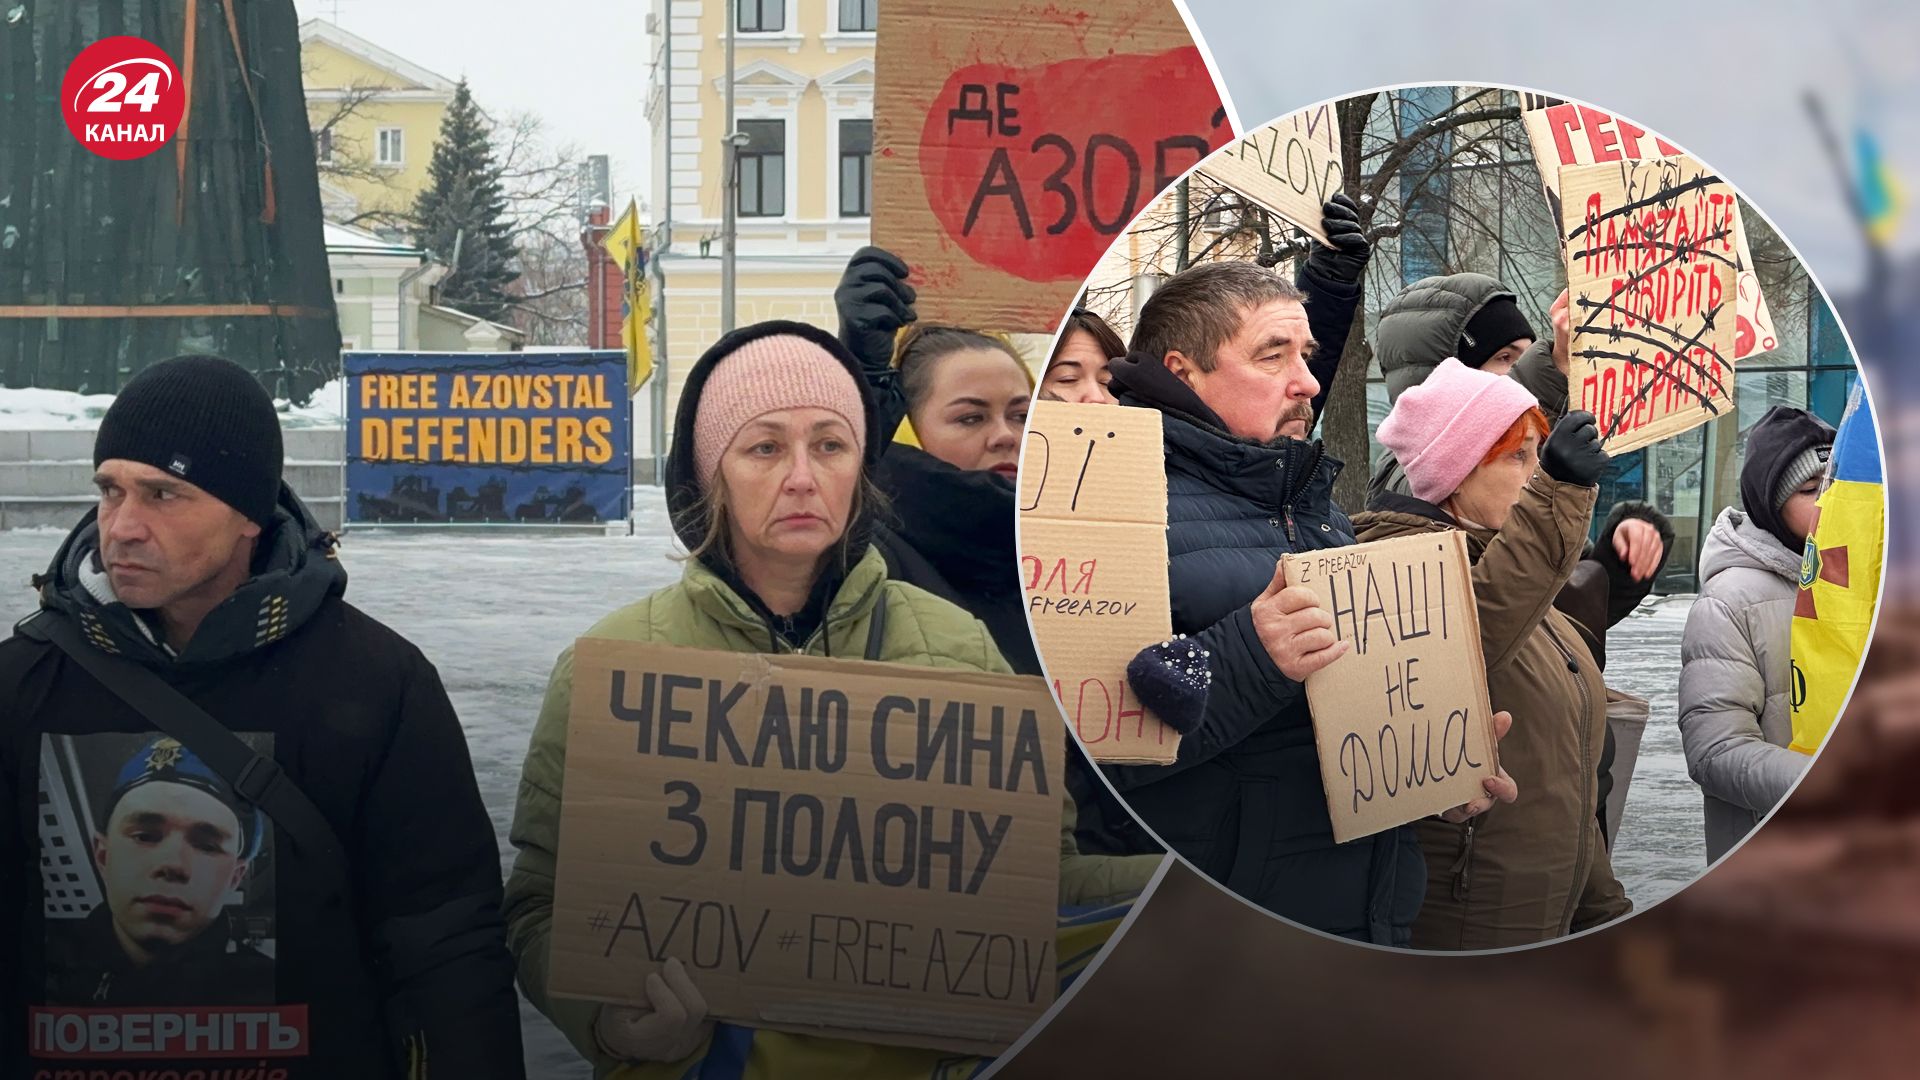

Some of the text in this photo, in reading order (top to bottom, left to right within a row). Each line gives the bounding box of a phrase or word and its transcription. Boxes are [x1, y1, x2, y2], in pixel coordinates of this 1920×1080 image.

[947, 82, 1021, 137] ДЕ
[361, 374, 613, 410] FREE AZOVSTAL
[361, 418, 613, 464] DEFENDERS
[1329, 544, 1448, 655] НАШІ
[1385, 658, 1424, 717] НЕ
[609, 669, 1050, 796] ЧЕКАЮ СИНА
[650, 781, 1012, 896] З ПОЛОНУ
[587, 892, 770, 973] #AZOV
[34, 1012, 301, 1053] ПОВЕРНІТЬ
